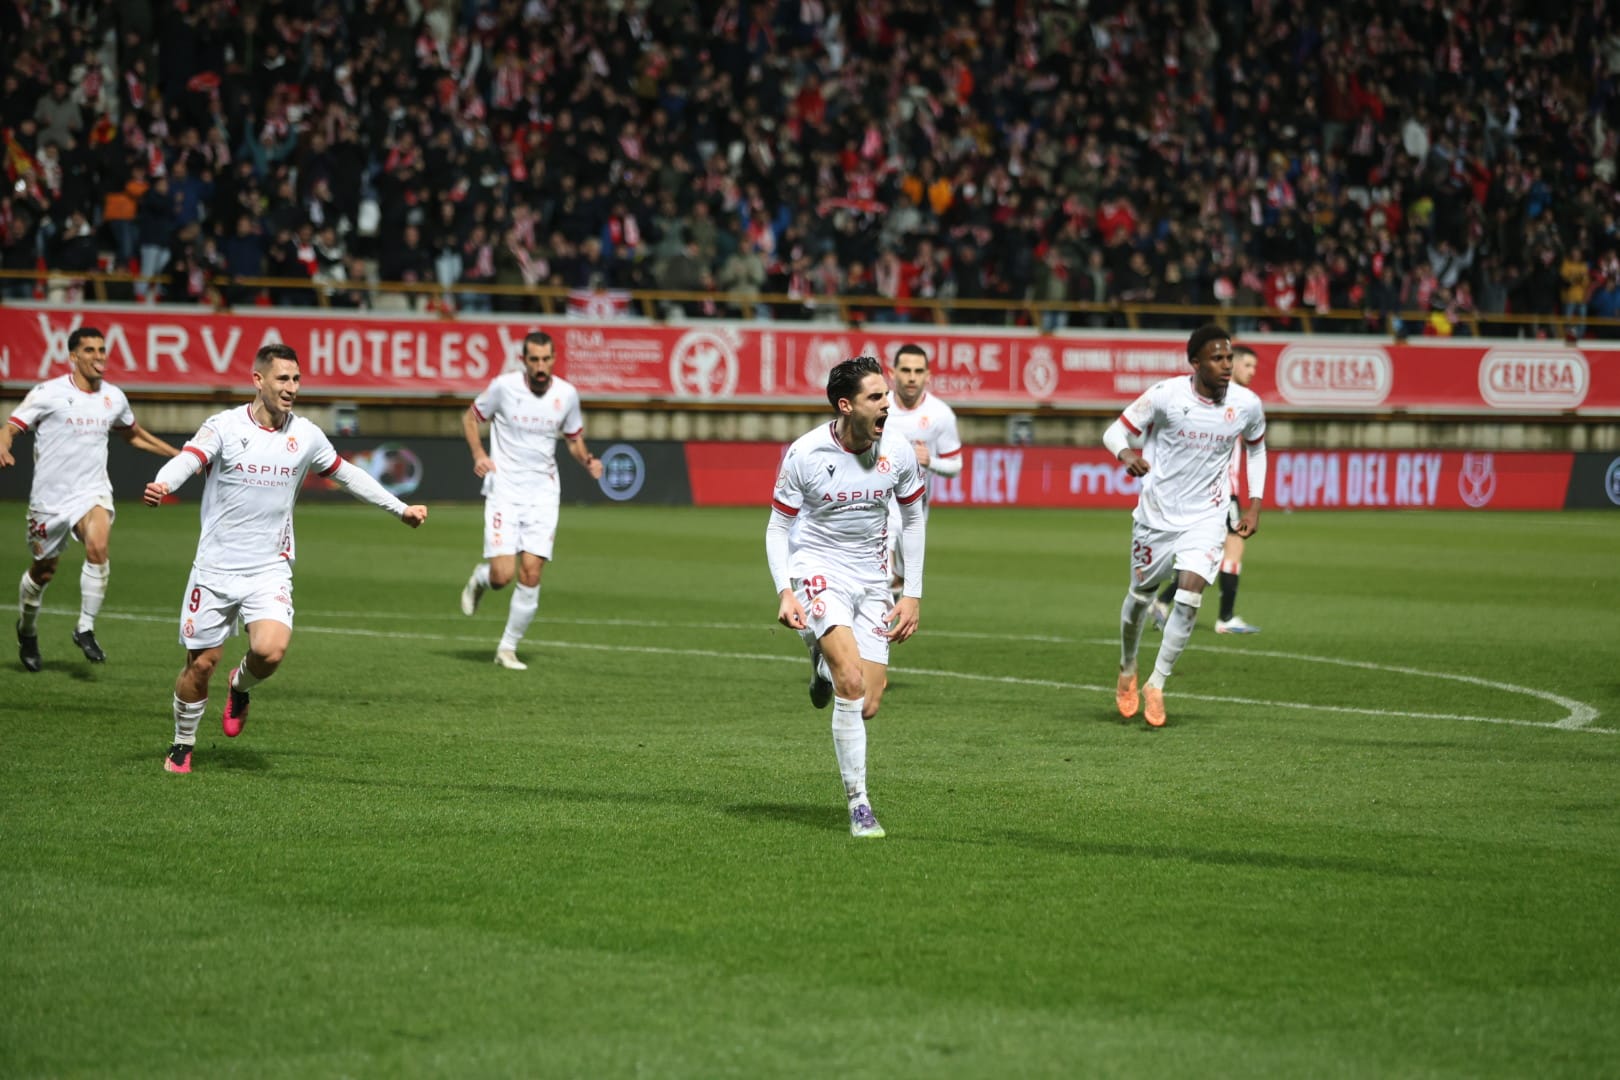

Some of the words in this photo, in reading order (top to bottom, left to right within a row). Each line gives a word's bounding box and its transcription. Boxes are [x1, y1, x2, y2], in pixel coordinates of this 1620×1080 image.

[309, 328, 490, 379] HOTELES
[1177, 429, 1234, 442] ASPIRE
[234, 462, 298, 478] ASPIRE
[971, 448, 1024, 503] REY
[1274, 452, 1340, 507] COPA
[1346, 453, 1389, 506] DEL
[1395, 453, 1441, 506] REY
[493, 512, 502, 529] 6
[1132, 540, 1152, 565] 23
[802, 574, 827, 601] 19
[189, 588, 201, 613] 9
